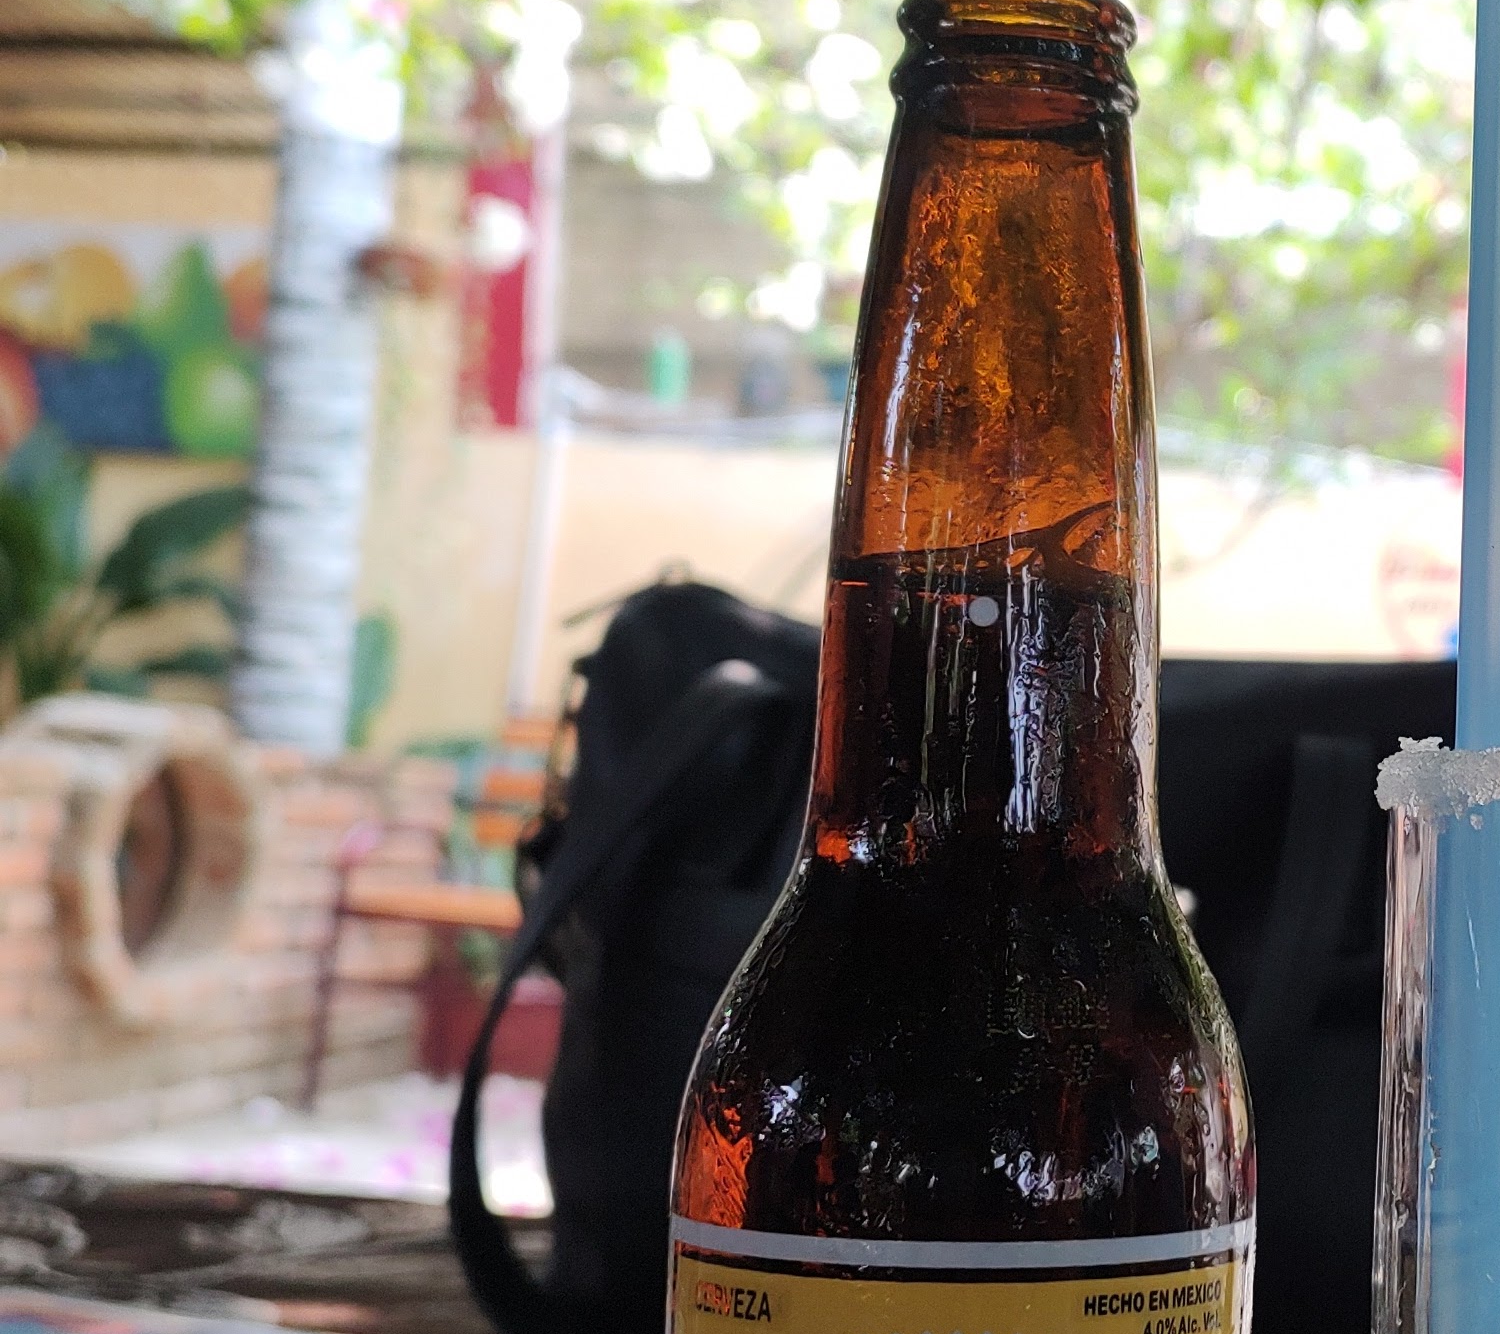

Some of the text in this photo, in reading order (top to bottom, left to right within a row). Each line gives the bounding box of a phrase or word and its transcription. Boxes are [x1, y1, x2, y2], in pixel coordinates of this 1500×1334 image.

[1084, 1280, 1222, 1316] HECHO EN MEXICO
